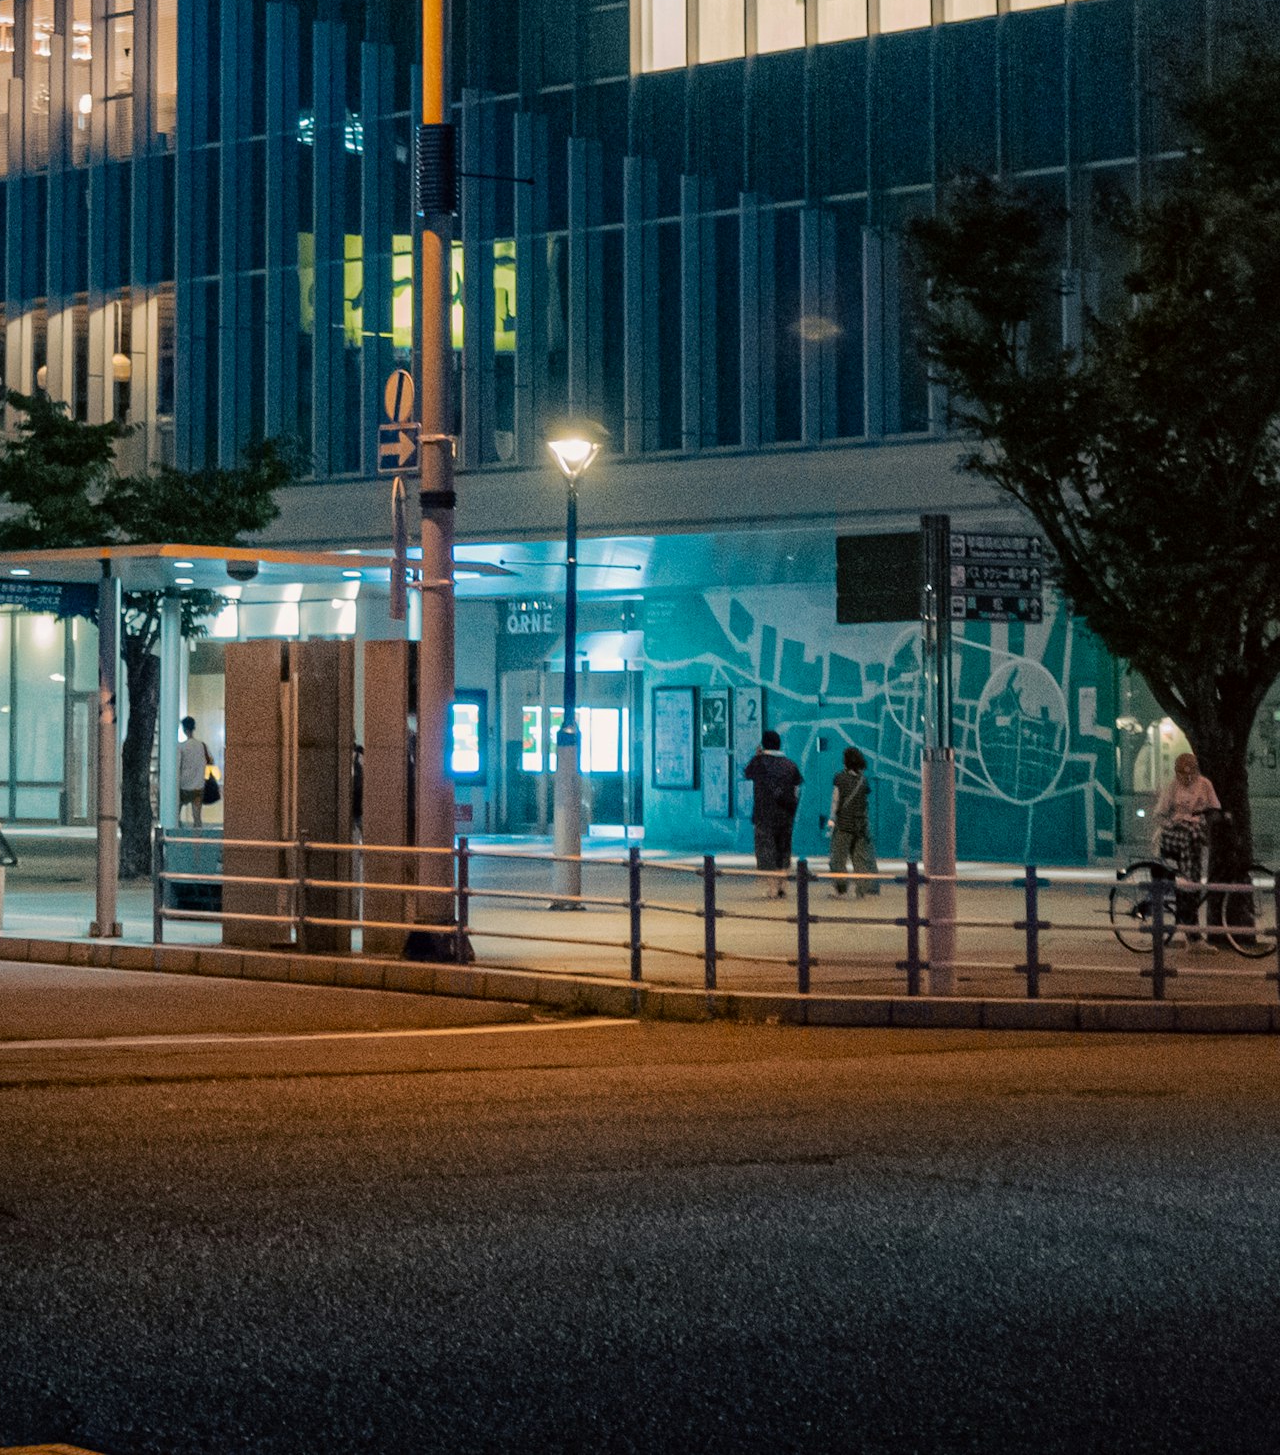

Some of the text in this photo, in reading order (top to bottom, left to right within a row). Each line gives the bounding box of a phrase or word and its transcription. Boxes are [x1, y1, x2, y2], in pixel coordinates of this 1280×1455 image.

[507, 613, 552, 634] ORNE
[713, 699, 724, 723] 2
[747, 698, 757, 722] 2
